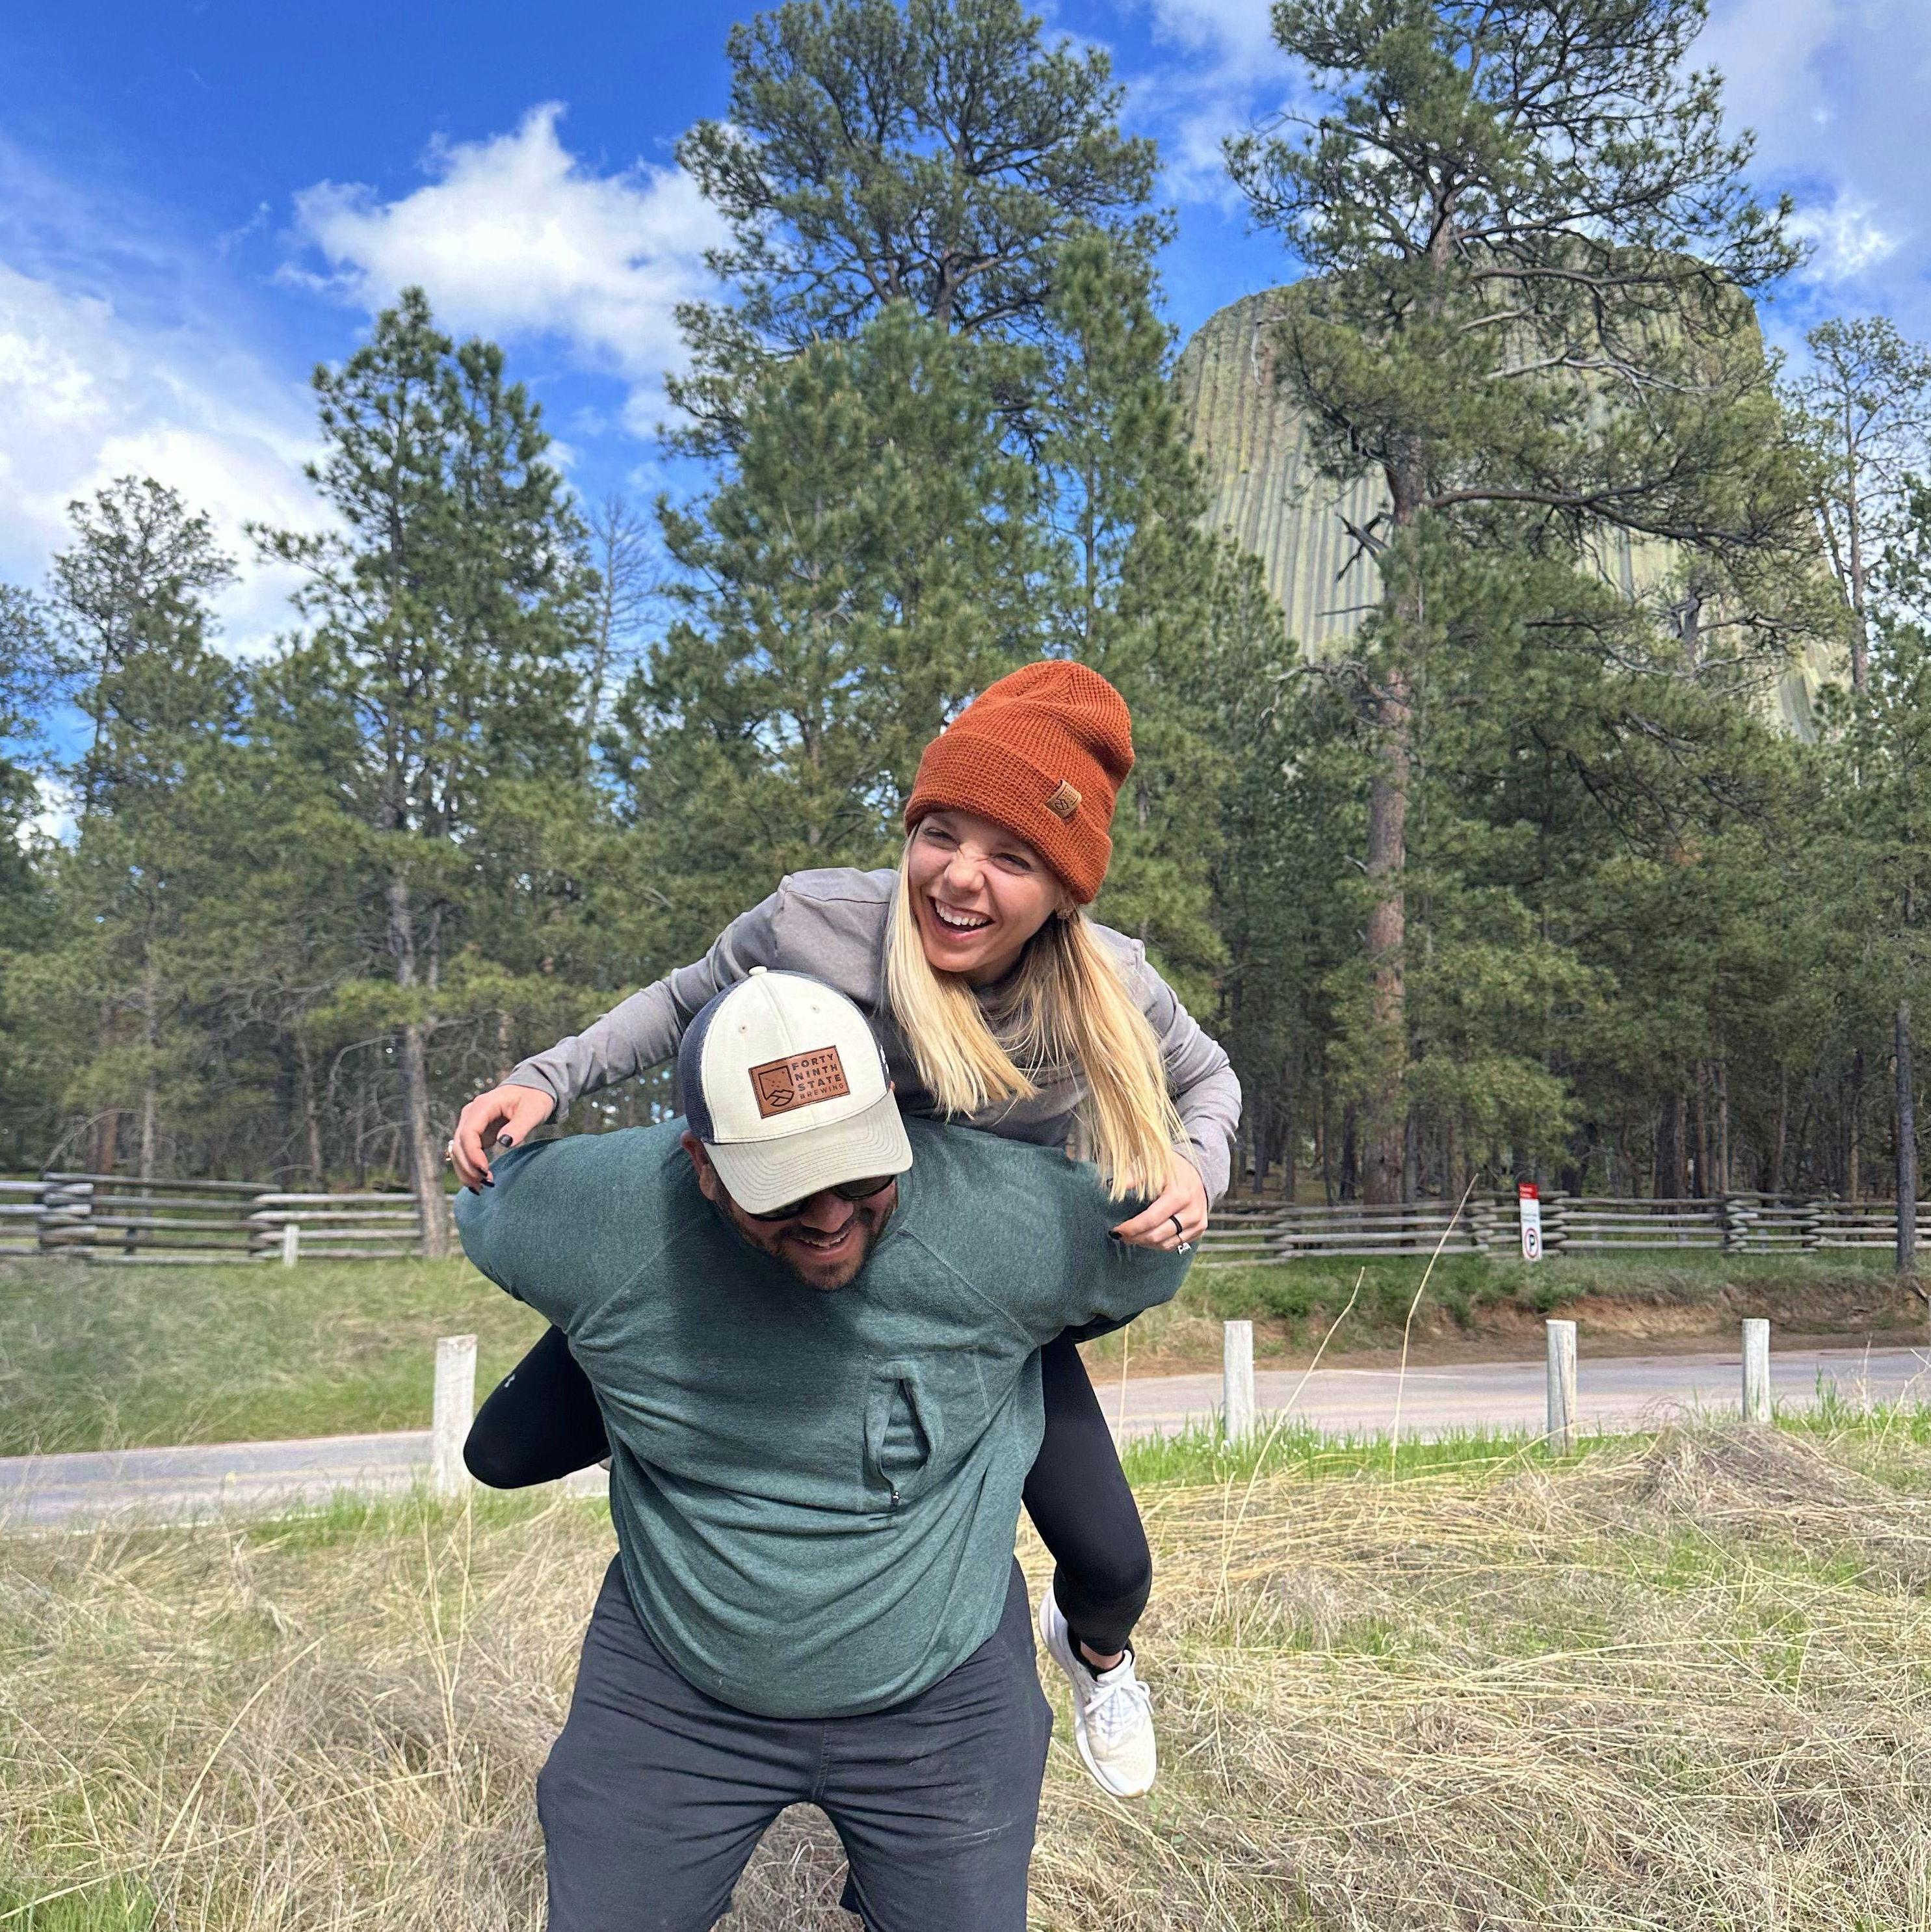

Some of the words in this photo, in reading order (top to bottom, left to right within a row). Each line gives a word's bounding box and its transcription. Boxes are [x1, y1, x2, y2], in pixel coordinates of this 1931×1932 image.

[792, 1053, 834, 1071] FORTY
[795, 1064, 838, 1081] NINTH
[798, 1074, 841, 1091] STATE
[800, 1083, 844, 1099] BREWING
[1529, 1234, 1535, 1252] P
